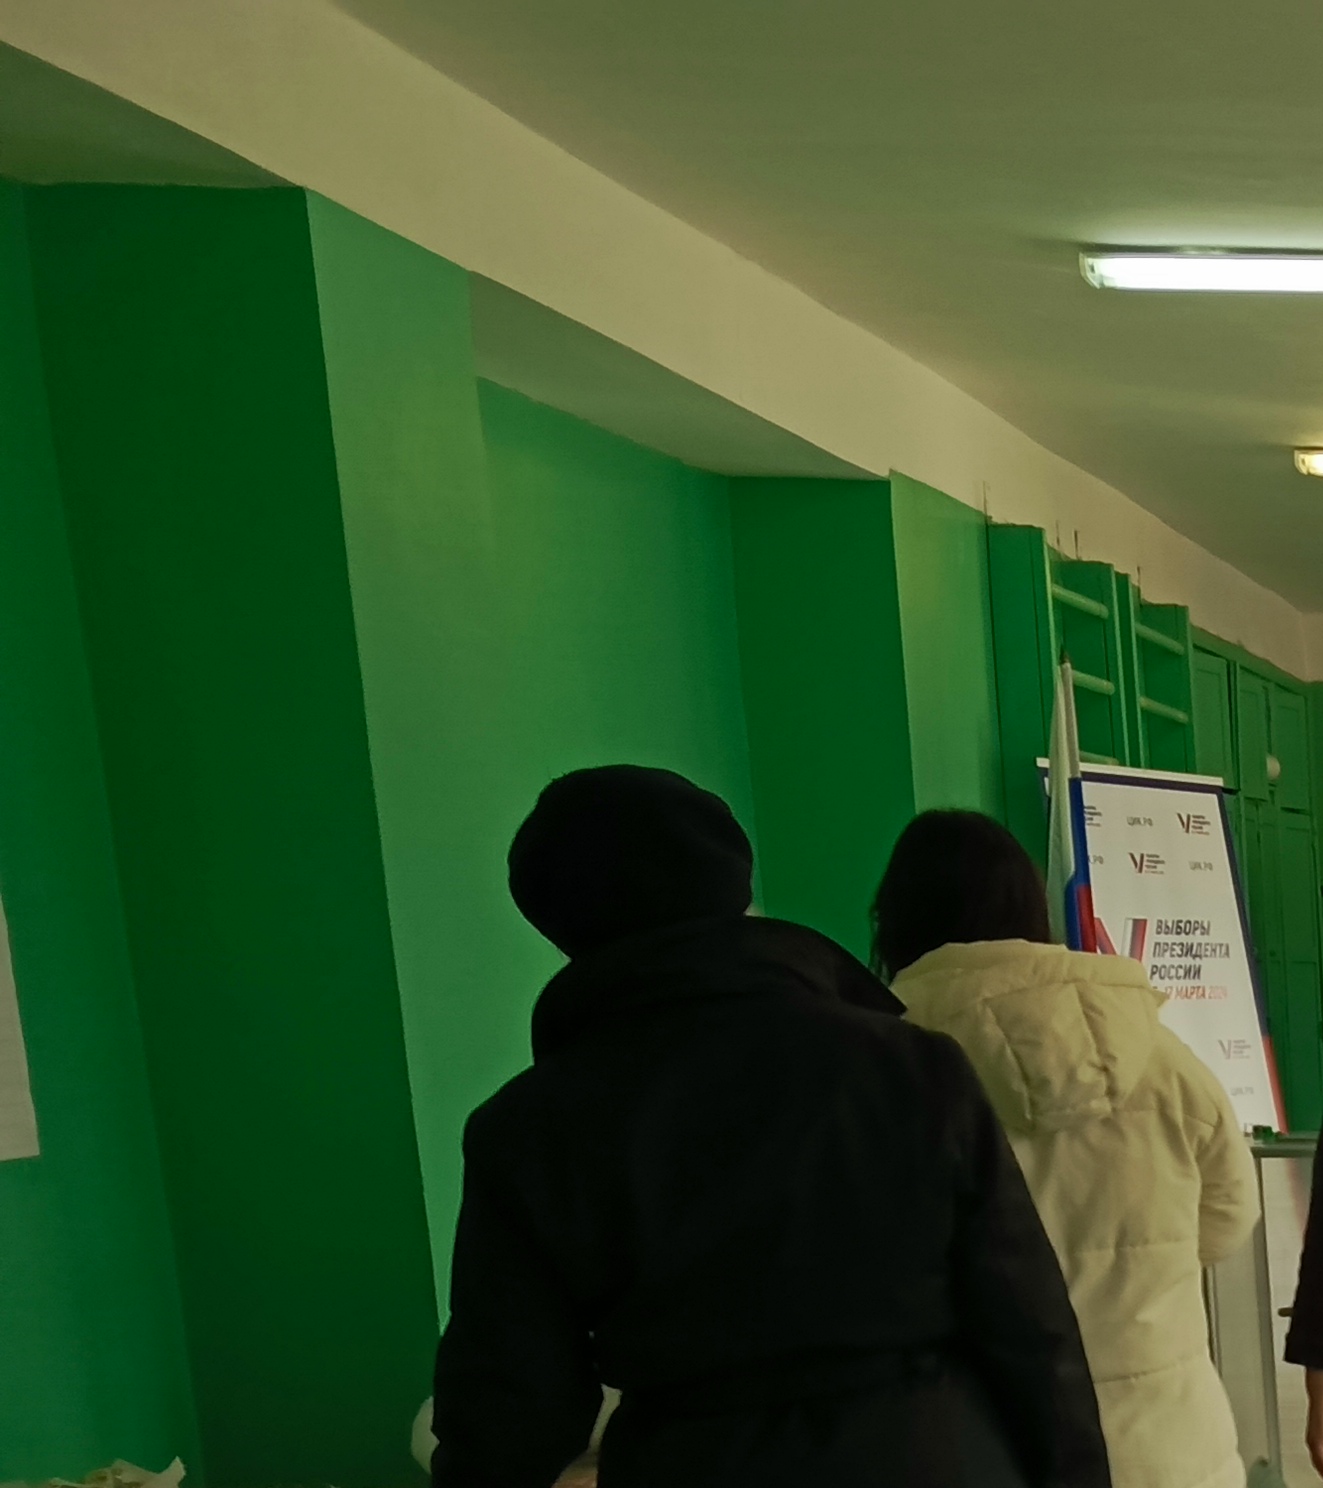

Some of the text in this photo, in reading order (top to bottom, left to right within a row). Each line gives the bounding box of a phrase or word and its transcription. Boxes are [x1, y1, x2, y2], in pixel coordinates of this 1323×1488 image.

[1155, 919, 1211, 937] ВЫБОРЫ
[1152, 941, 1230, 960] ПРЕЗИДЕНТА
[1149, 964, 1202, 981] РОССИИ
[1174, 986, 1206, 1000] МАРТА
